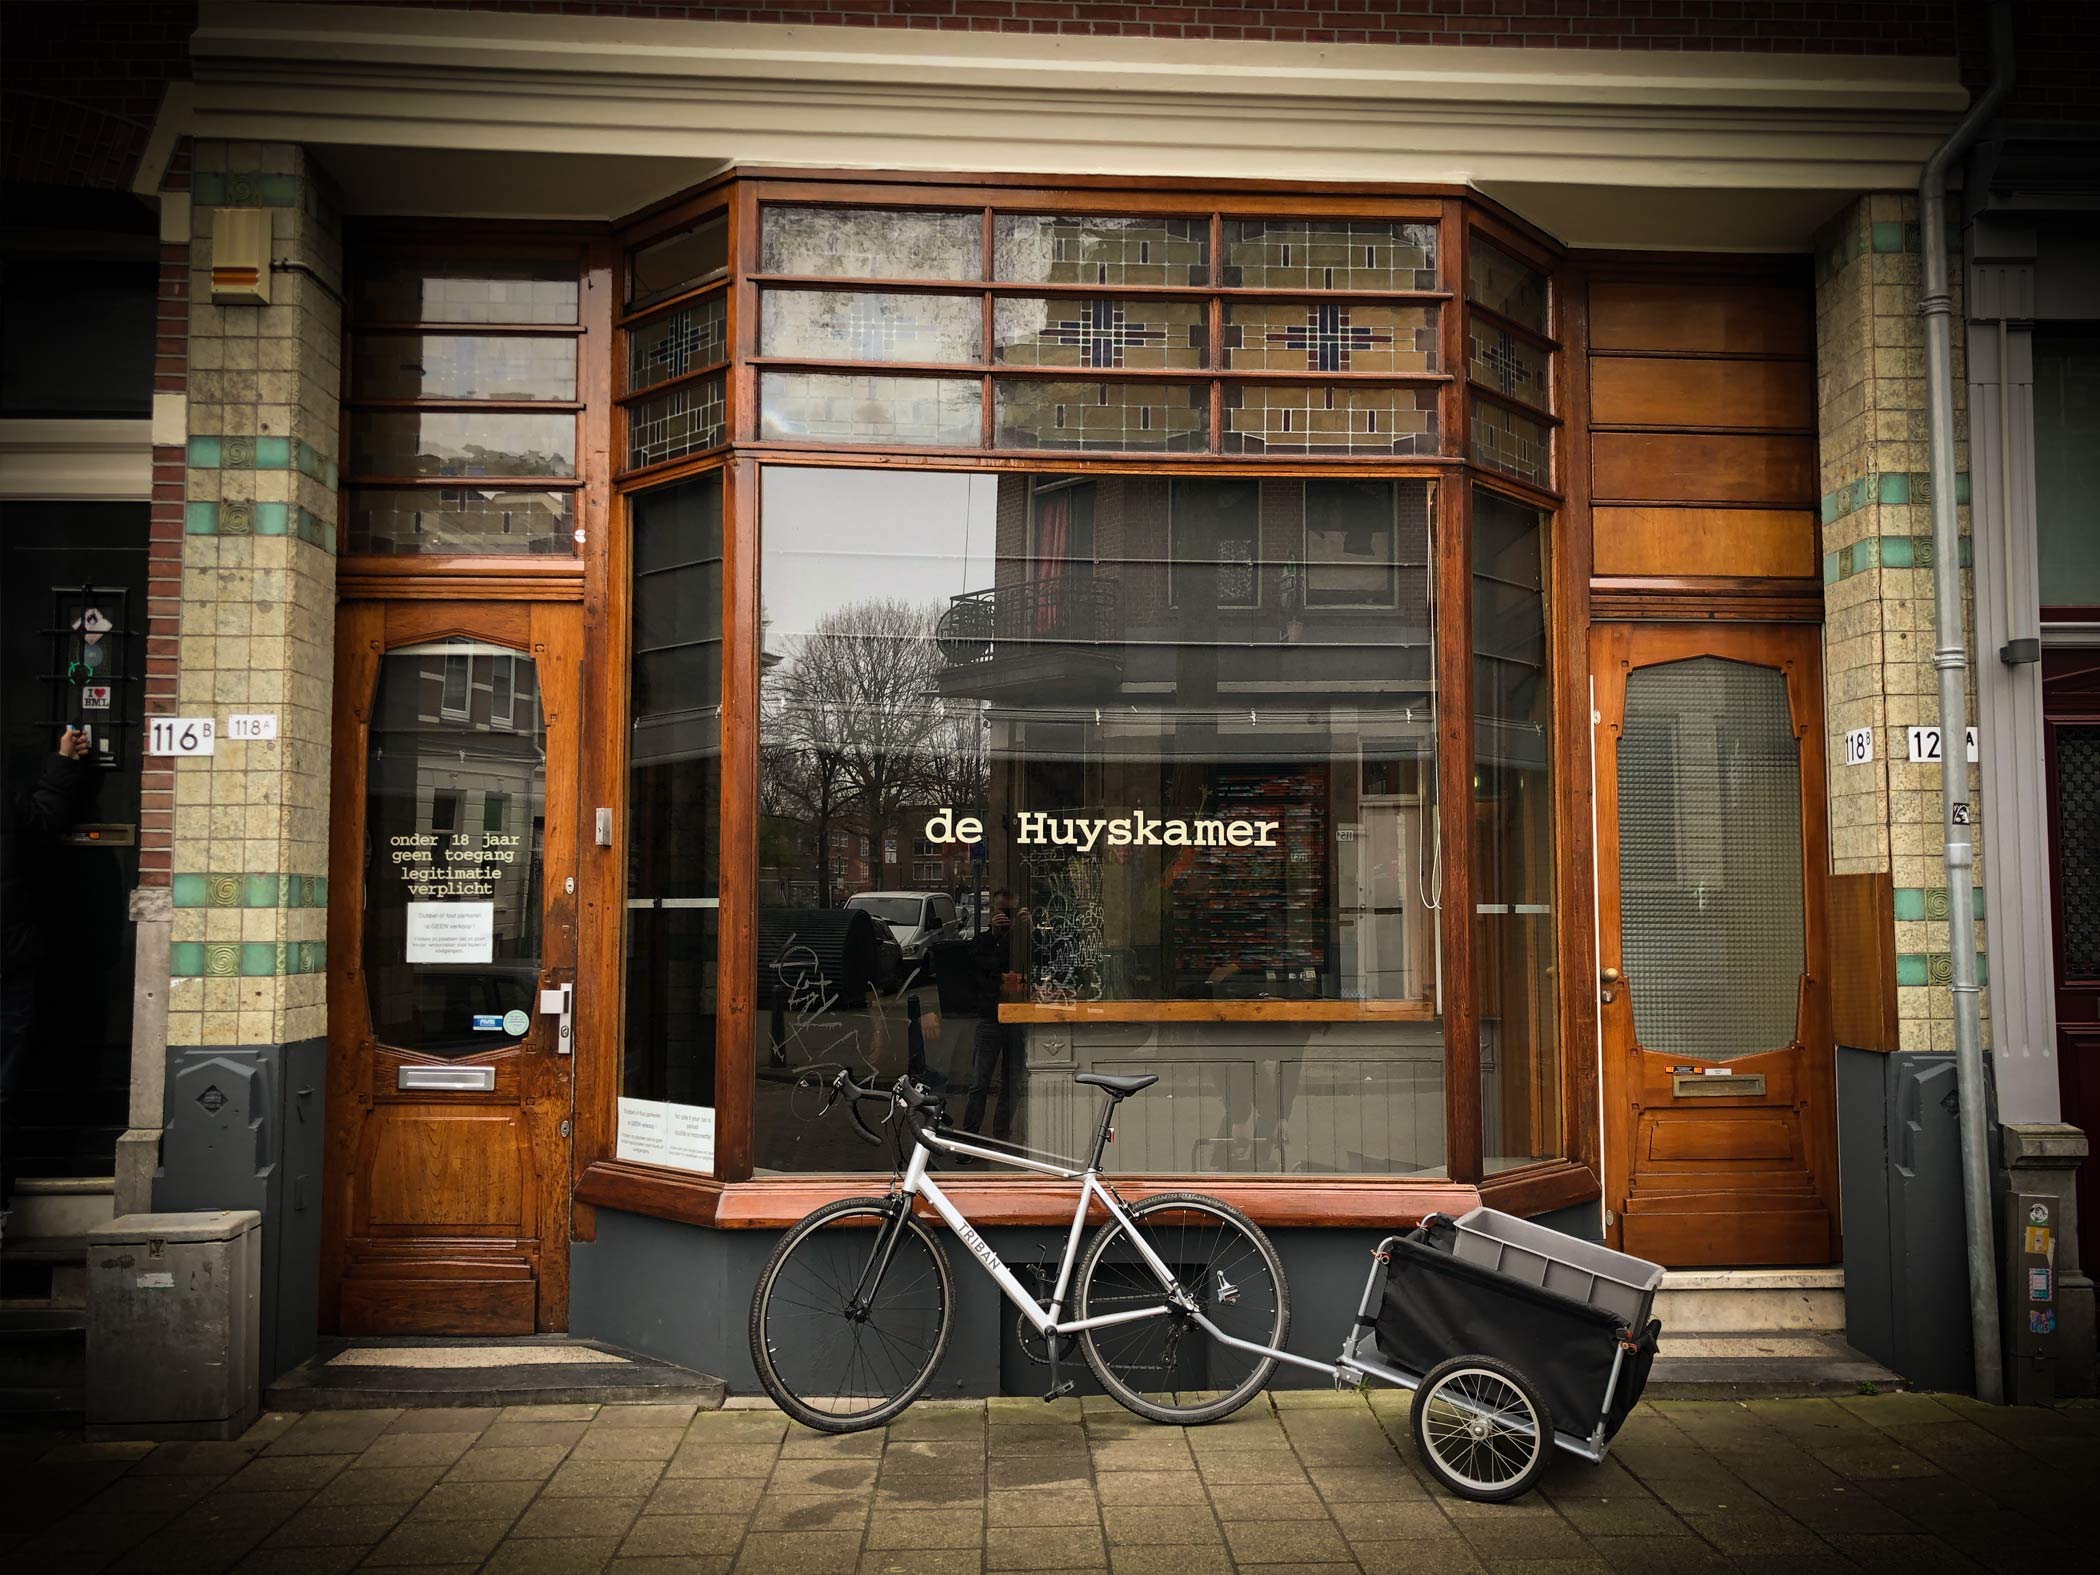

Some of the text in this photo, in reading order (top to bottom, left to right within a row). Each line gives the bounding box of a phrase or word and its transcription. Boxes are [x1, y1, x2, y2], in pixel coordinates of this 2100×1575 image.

[84, 698, 110, 707] BML
[925, 808, 1279, 852] de Huyskamer
[390, 833, 520, 848] onder 18 jaar
[392, 849, 515, 864] geen toegang
[401, 867, 502, 881] legitimatie
[408, 882, 493, 897] verplicht
[958, 1221, 1001, 1271] TRIBAN
